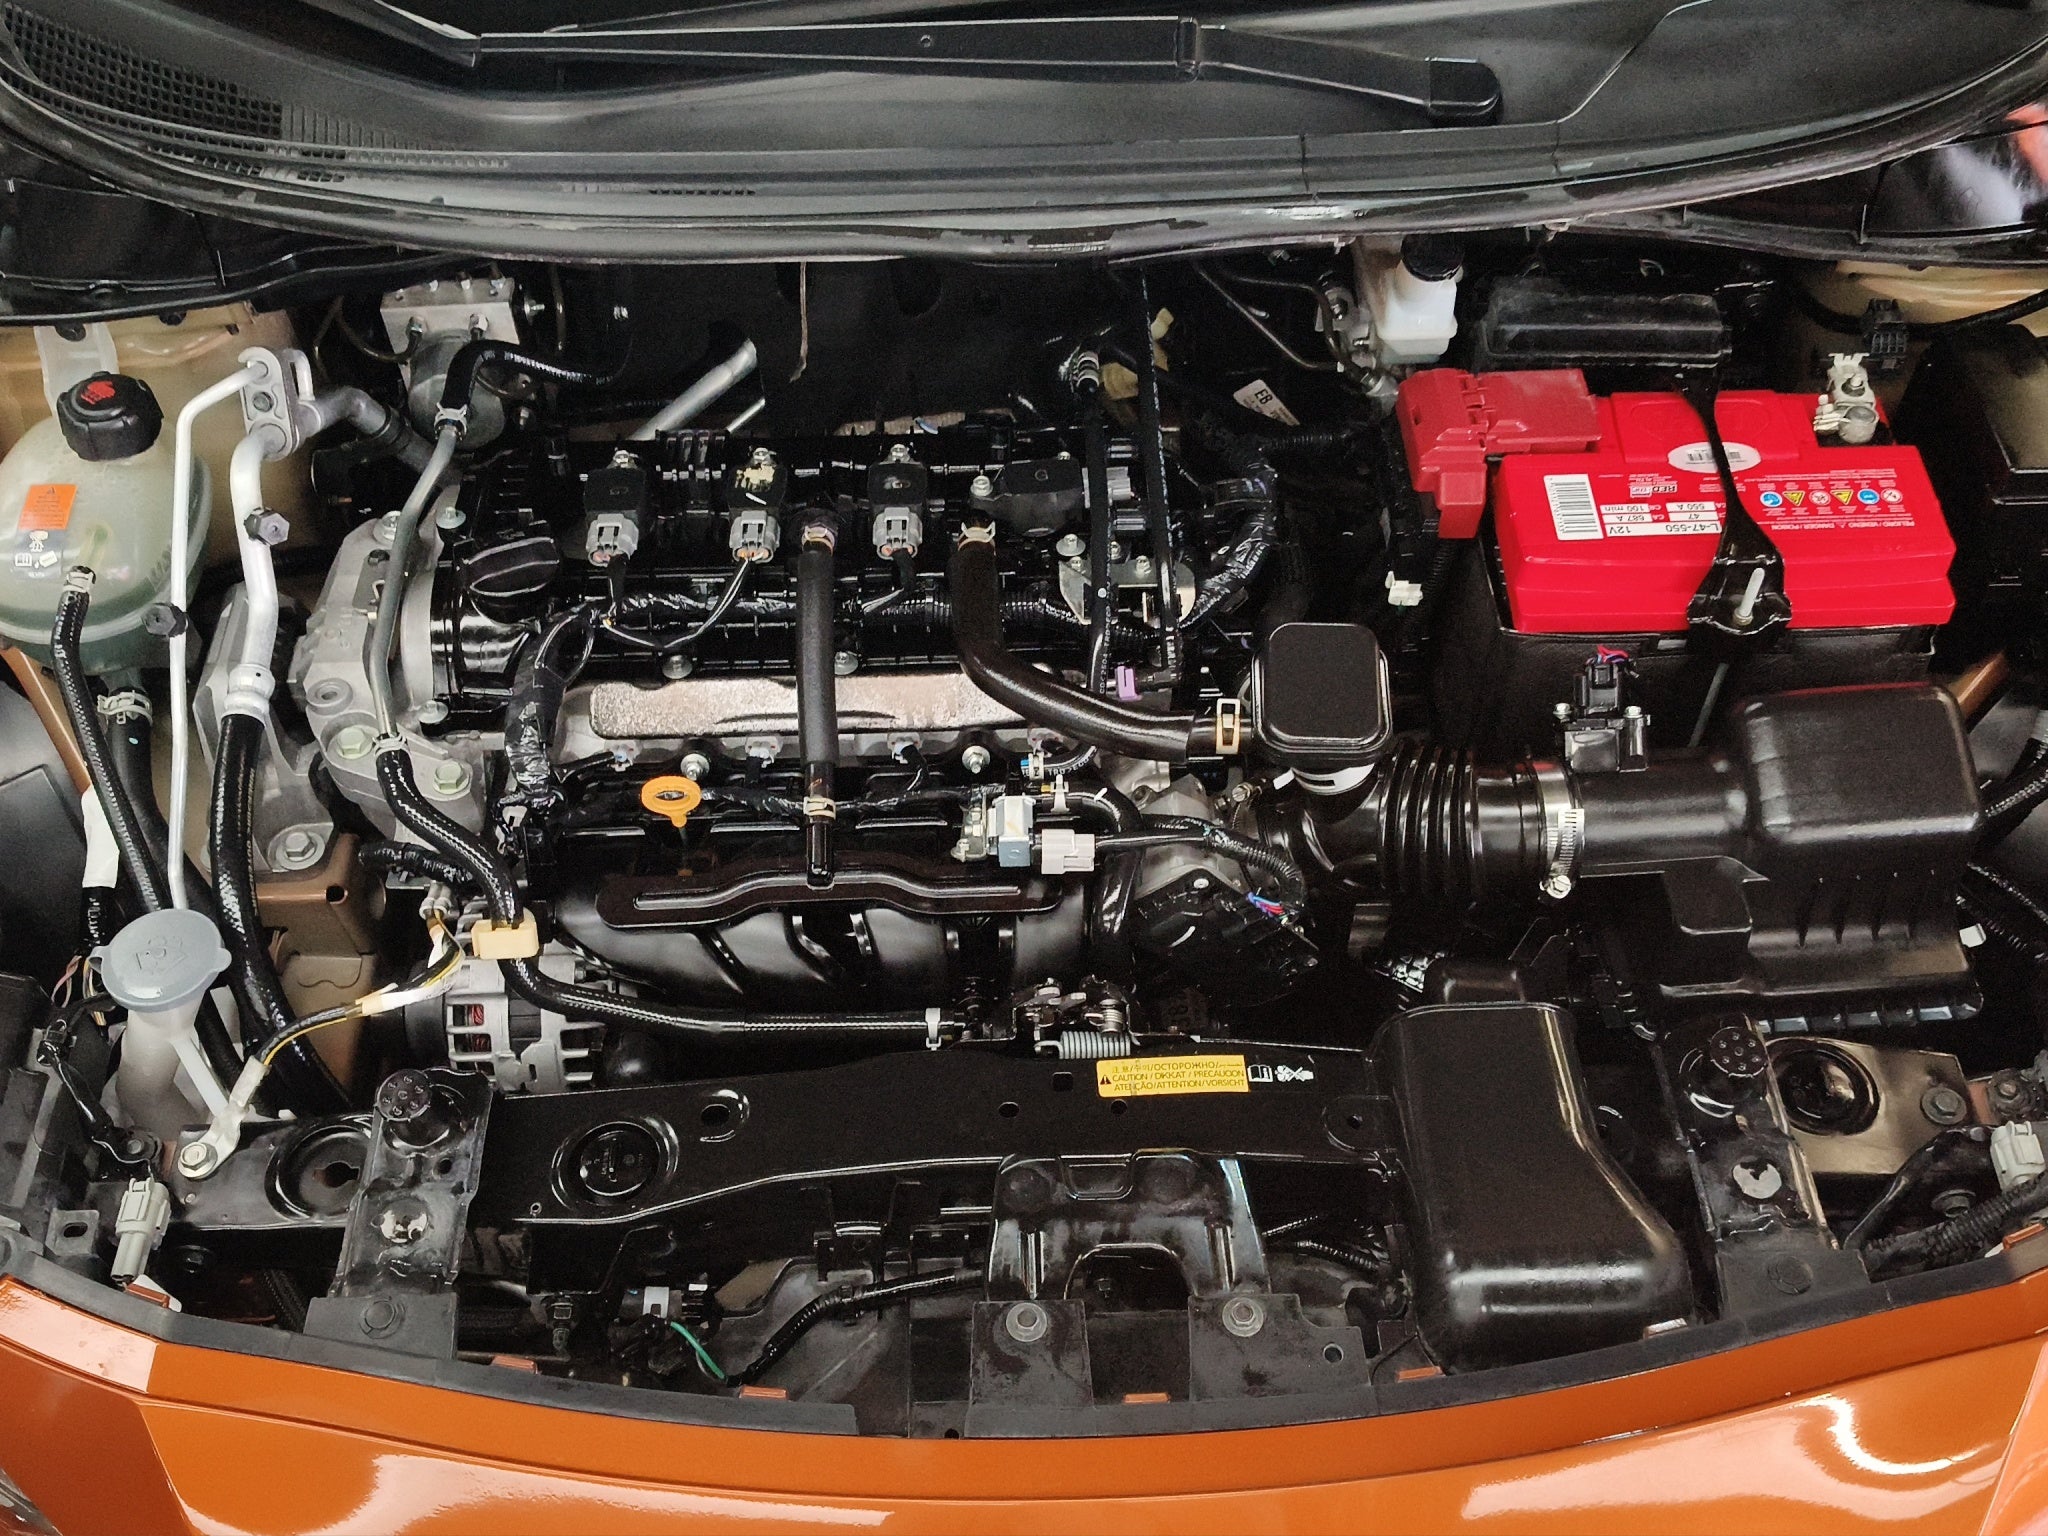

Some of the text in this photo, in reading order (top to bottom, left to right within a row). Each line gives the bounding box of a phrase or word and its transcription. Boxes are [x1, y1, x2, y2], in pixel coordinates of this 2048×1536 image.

[1254, 388, 1273, 404] EB
[1688, 512, 1700, 520] 47
[1608, 522, 1719, 535] L-47-550 12V
[1112, 1073, 1148, 1082] CAUTION
[1154, 1071, 1186, 1080] DIKKAT
